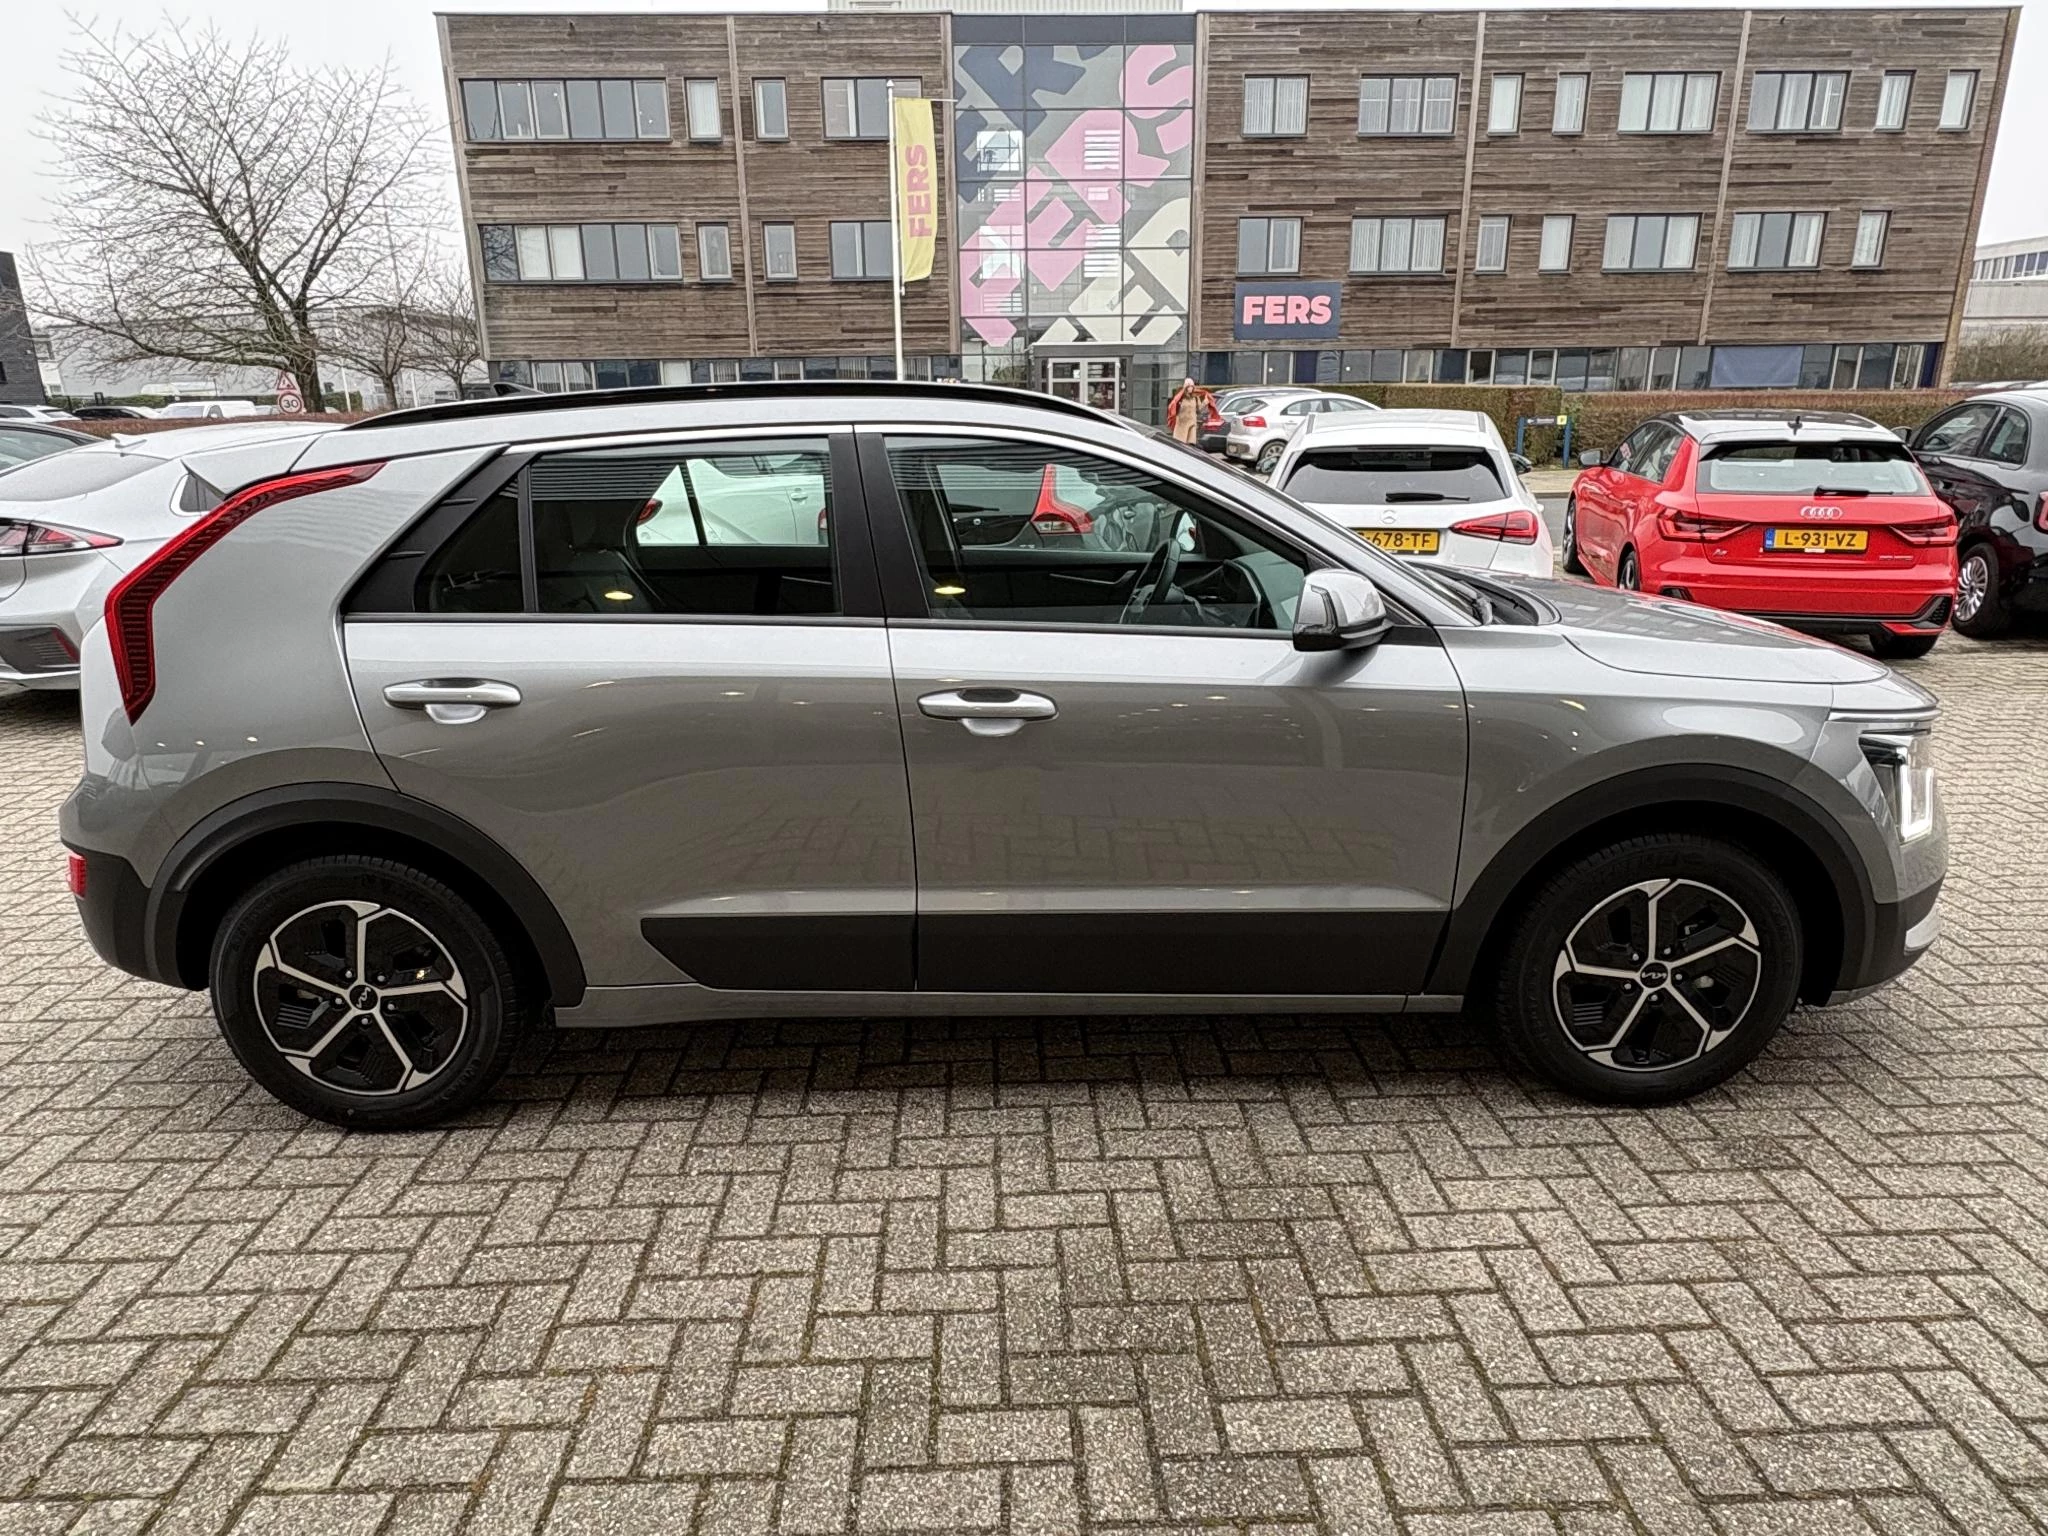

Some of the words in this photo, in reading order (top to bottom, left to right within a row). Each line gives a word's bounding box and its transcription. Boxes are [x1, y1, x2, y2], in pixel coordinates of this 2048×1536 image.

[905, 144, 933, 237] FERS
[1243, 295, 1332, 324] FERS
[284, 399, 299, 408] 30
[1784, 531, 1857, 548] L-931-VZ
